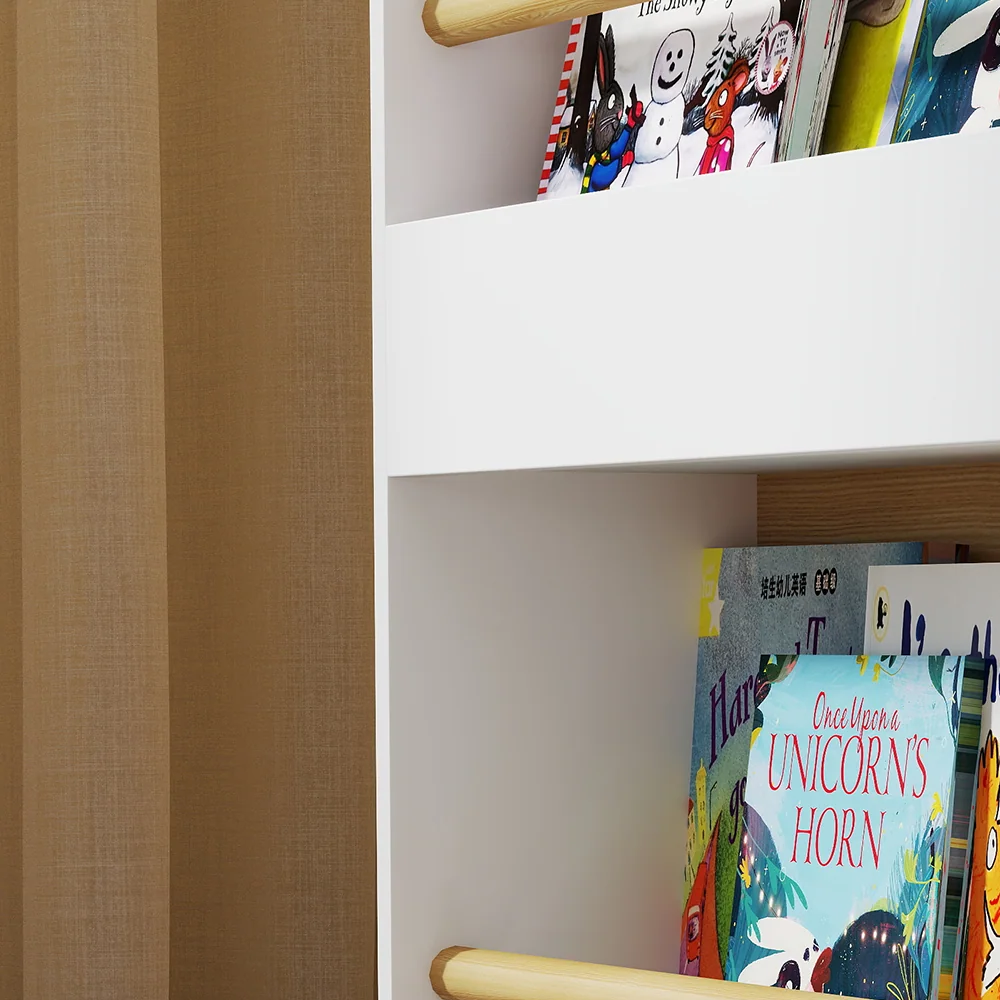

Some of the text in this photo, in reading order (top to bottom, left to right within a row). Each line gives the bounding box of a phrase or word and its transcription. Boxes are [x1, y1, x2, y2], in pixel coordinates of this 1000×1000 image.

[709, 668, 759, 770] Har
[813, 691, 901, 754] Once Upon a
[768, 733, 930, 799] UNICORN'S
[790, 806, 887, 870] HORN
